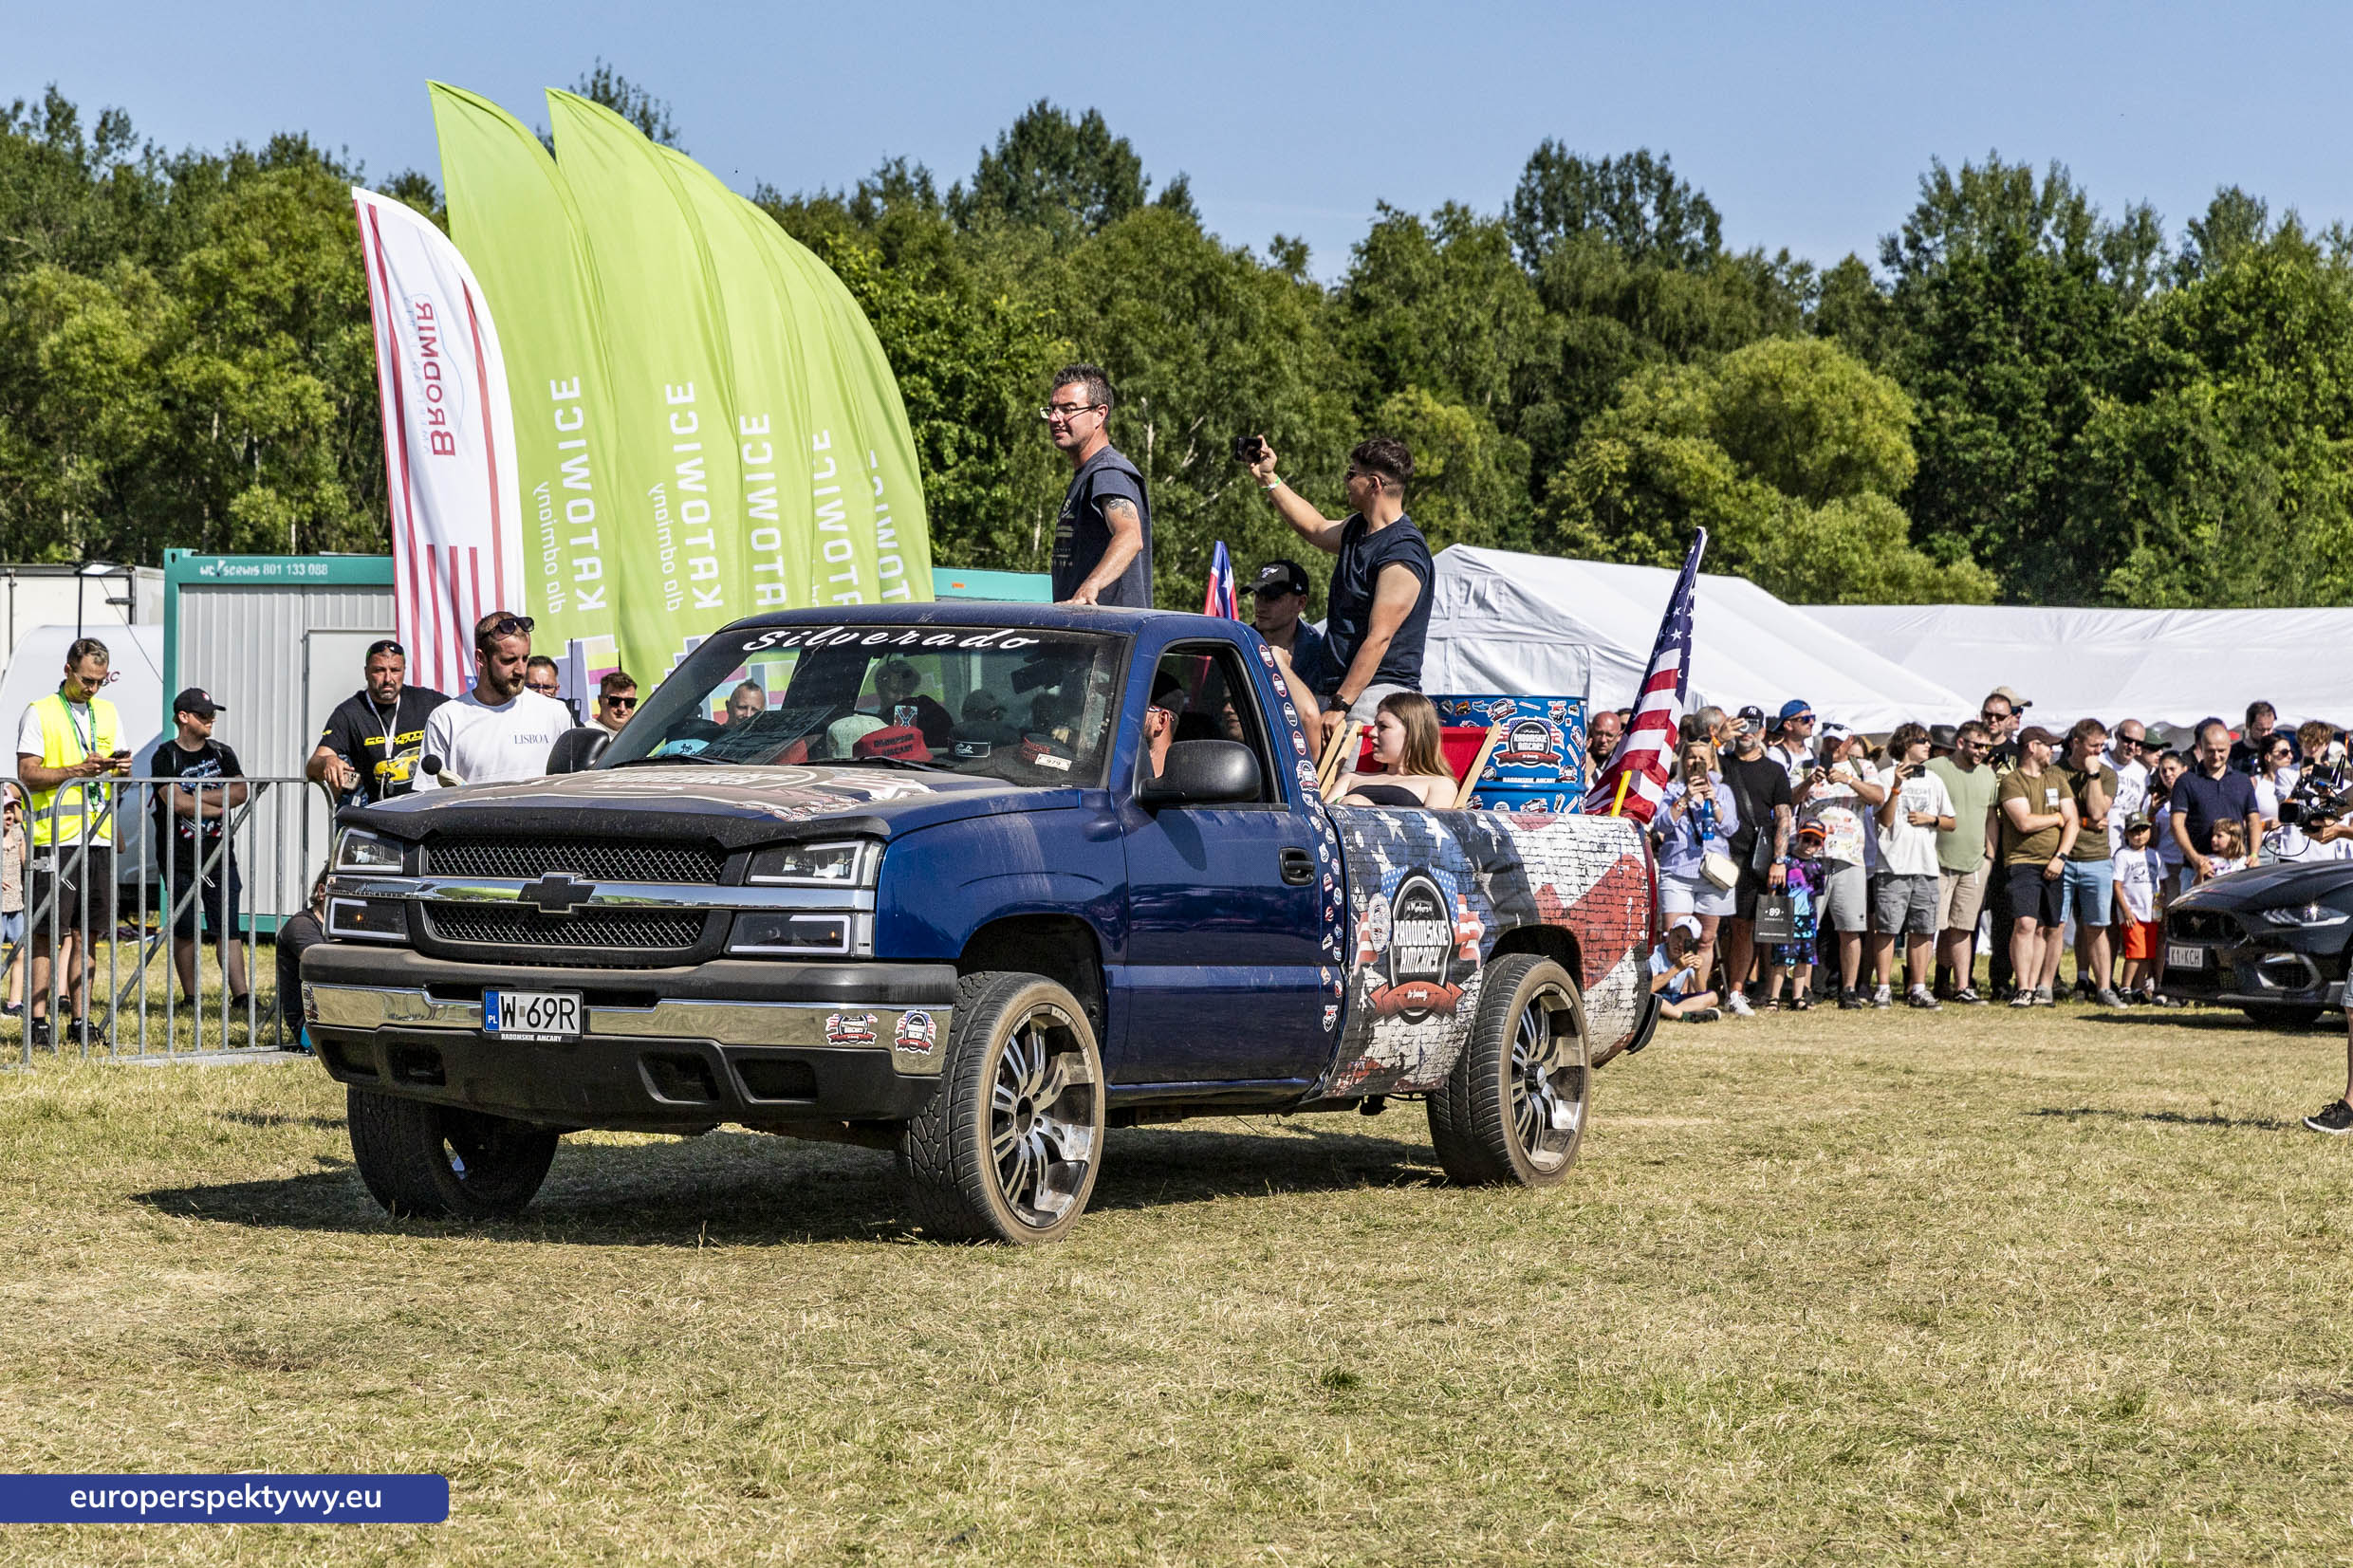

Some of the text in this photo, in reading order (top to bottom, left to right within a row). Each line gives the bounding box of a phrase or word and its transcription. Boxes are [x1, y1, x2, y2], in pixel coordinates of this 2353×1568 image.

[263, 563, 282, 575] 801
[286, 563, 306, 575] 133
[308, 563, 328, 575] 088
[742, 625, 1040, 651] Silverado
[513, 734, 549, 745] LISBOA
[1394, 919, 1449, 947] RADOMSKIE
[1399, 946, 1442, 974] AMCARY
[488, 1014, 498, 1024] PL
[500, 995, 576, 1030] W 69R
[501, 1033, 563, 1042] RADOMSKIE AMCARY
